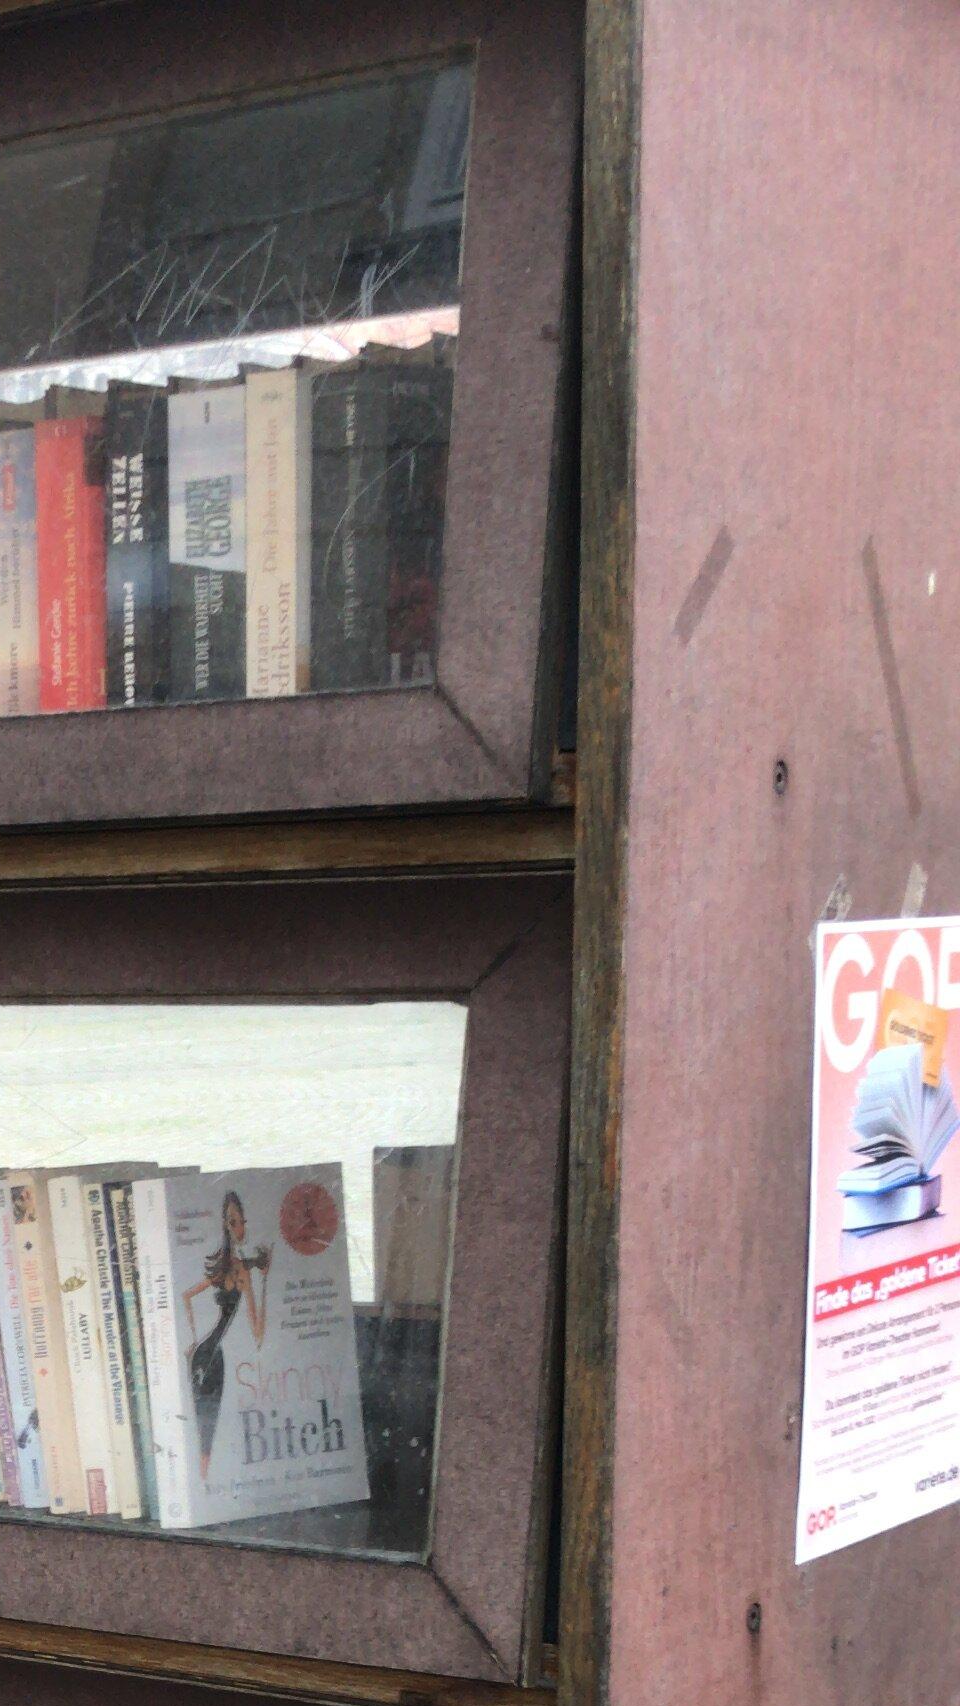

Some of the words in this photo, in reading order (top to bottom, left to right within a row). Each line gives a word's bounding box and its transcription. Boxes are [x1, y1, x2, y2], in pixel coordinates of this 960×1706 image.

[203, 475, 232, 557] GEORGE
[252, 604, 272, 697] arianne
[91, 1208, 107, 1248] Agatha
[96, 1249, 113, 1289] Christie
[10, 1296, 20, 1310] Die
[101, 1291, 115, 1312] The
[815, 1285, 850, 1315] Finde
[850, 1279, 874, 1304] das
[32, 1306, 47, 1359] Hoffnung
[78, 1312, 92, 1360] LULLABY
[103, 1313, 119, 1351] Murder
[109, 1352, 119, 1363] at
[109, 1364, 123, 1382] the
[19, 1365, 32, 1407] PATRICIA
[236, 1360, 343, 1407] Skinny
[111, 1383, 127, 1427] Vicarage
[238, 1398, 346, 1465] Bitch
